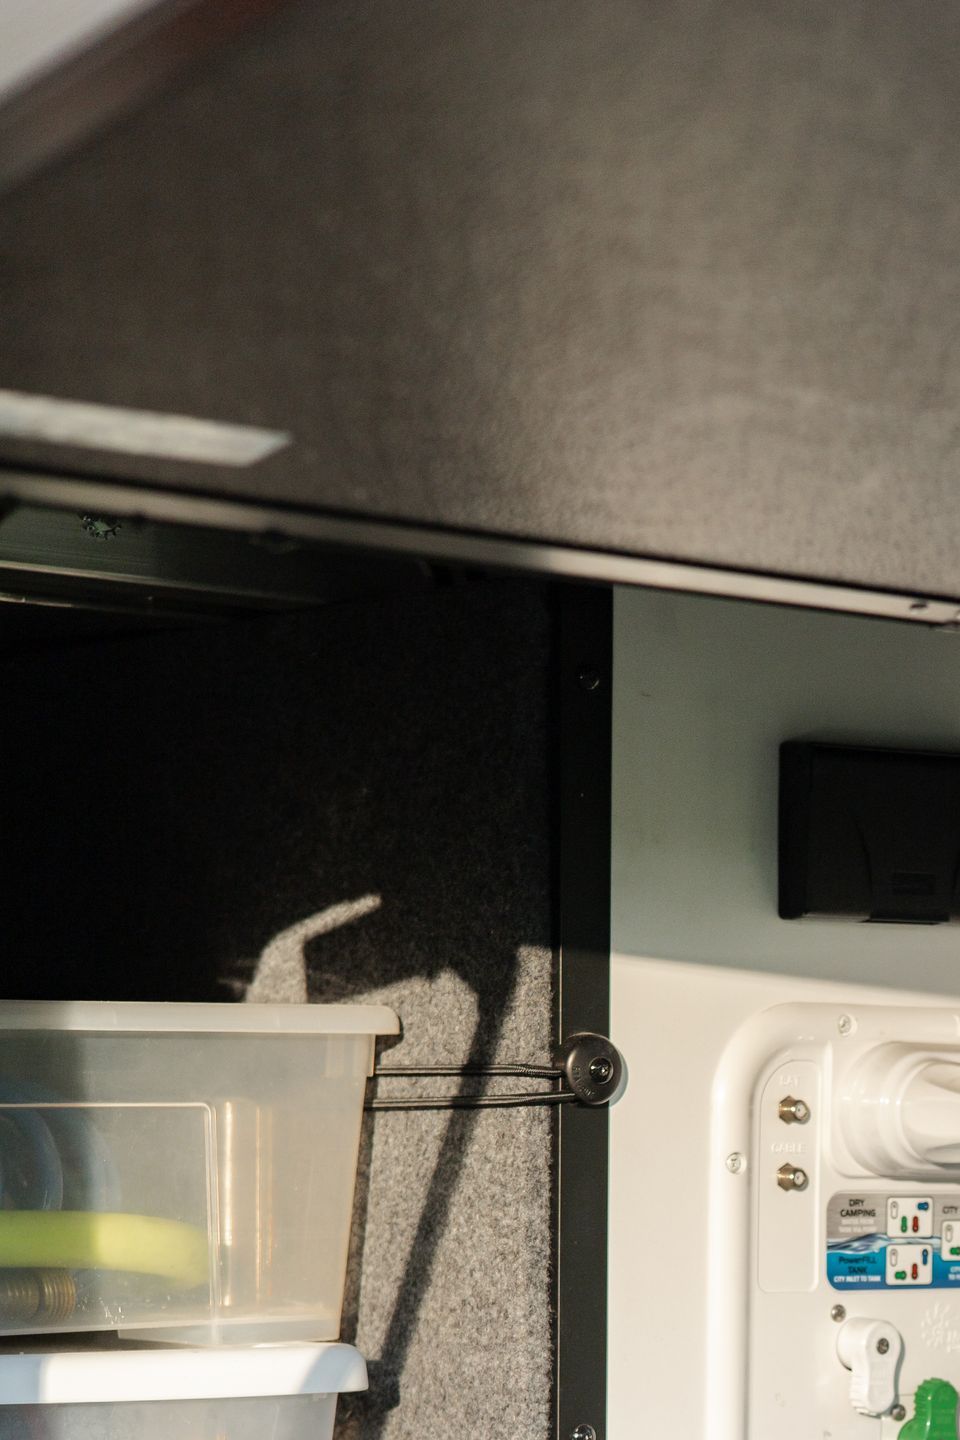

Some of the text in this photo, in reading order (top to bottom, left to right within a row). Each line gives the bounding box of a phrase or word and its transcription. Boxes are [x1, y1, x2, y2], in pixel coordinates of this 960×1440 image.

[848, 1199, 866, 1208] DRY
[840, 1209, 876, 1218] CAMPING
[943, 1206, 958, 1214] CITY
